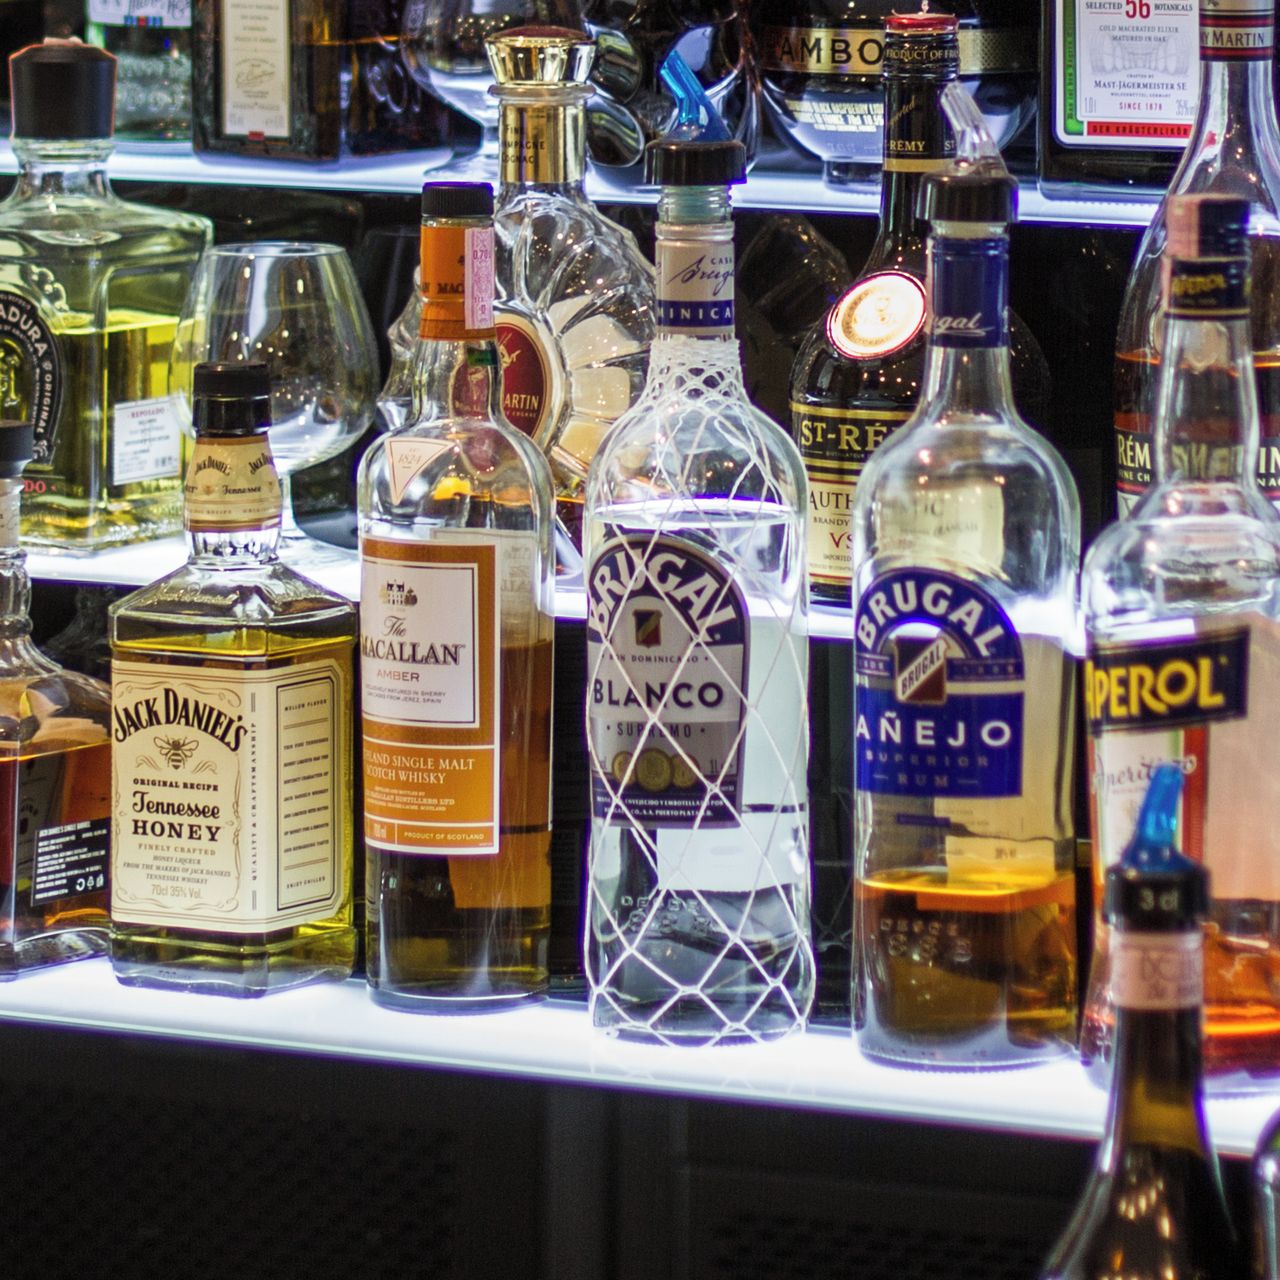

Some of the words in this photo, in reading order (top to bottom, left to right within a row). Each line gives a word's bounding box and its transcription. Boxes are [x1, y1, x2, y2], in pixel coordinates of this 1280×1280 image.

[1085, 1, 1123, 11] SELECTED
[1154, 2, 1193, 12] BOTANICALS
[1099, 24, 1116, 33] COLD
[1118, 25, 1156, 33] MACERATED
[1157, 25, 1179, 34] ELIXIR
[1111, 34, 1144, 43] MATURED
[1211, 29, 1265, 48] MARTIN
[929, 48, 943, 61] OF
[1093, 78, 1175, 91] MAST-JÄGERMEISTER
[1176, 80, 1187, 91] SE
[1119, 101, 1141, 111] SINCE
[1144, 102, 1163, 111] 1878
[35, 373, 54, 434] ORIGINAL
[813, 516, 850, 527] BRANDY
[589, 548, 736, 644] BRUGAL
[384, 615, 408, 637] The
[857, 580, 1005, 658] BRUGAL
[361, 633, 461, 666] MACALLAN
[631, 654, 699, 664] DOMINICANO
[376, 668, 421, 683] AMBER
[901, 642, 942, 696] BRUGAL
[421, 690, 447, 698] SHERRY
[422, 696, 442, 704] SPAIN
[593, 681, 725, 709] BLANCO
[114, 696, 162, 743] JACK
[163, 687, 249, 753] DANIEL'S
[617, 722, 693, 739] SUPREMO
[856, 711, 1012, 747] AÑEJO
[391, 755, 436, 770] SINGLE
[439, 758, 475, 770] MALT
[865, 749, 989, 767] SUPERIOR
[133, 778, 180, 789] ORIGINAL
[182, 782, 219, 792] RECIPE
[398, 770, 447, 785] WHISKY
[897, 772, 949, 788] RUM
[132, 790, 220, 819] Tennessee
[132, 819, 221, 842] HONEY
[404, 831, 434, 840] PRODUCT
[447, 833, 485, 841] SCOTLAND
[138, 843, 171, 852] FINELY
[174, 846, 216, 856] CRAFTED
[141, 863, 154, 871] THE
[155, 864, 181, 873] MAKERS
[146, 872, 180, 882] TENNESSEE
[152, 884, 168, 896] 70cl
[169, 885, 188, 898] 35%
[1139, 888, 1154, 909] 3
[1160, 888, 1180, 910] cl
